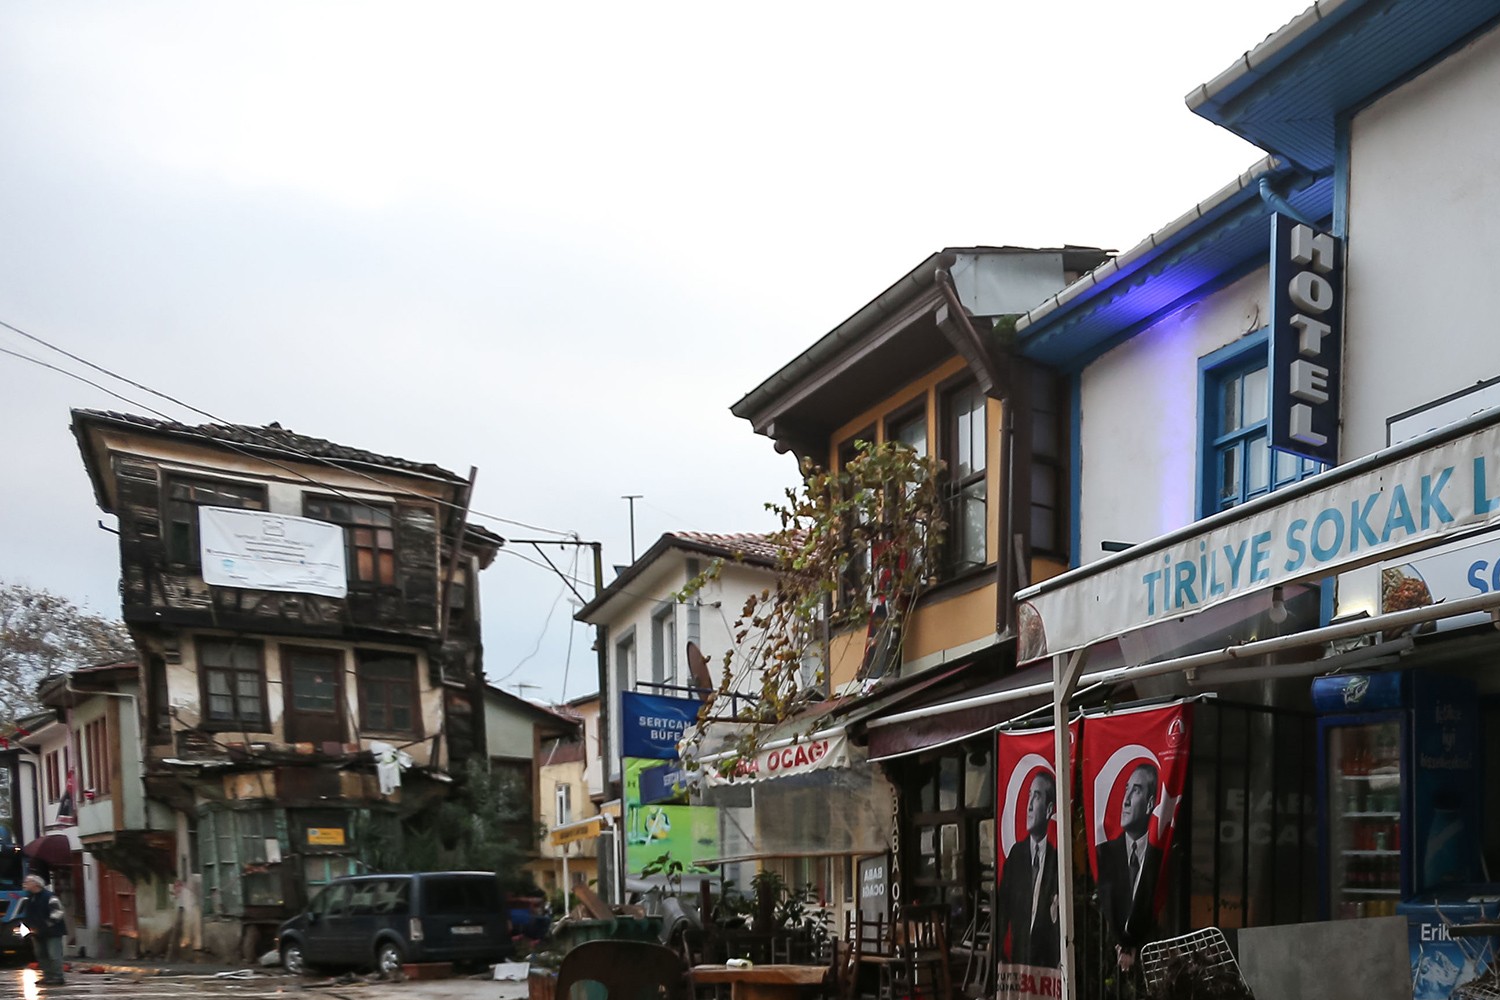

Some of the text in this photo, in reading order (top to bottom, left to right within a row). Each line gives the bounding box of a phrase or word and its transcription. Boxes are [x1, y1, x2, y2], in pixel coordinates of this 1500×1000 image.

[1289, 222, 1335, 448] HOTEL
[1142, 530, 1272, 617] TİRİLYE
[1284, 466, 1456, 573] SOKAK
[638, 715, 692, 730] SERTCAN
[650, 729, 680, 741] BÜFE
[1421, 923, 1460, 941] Erik
